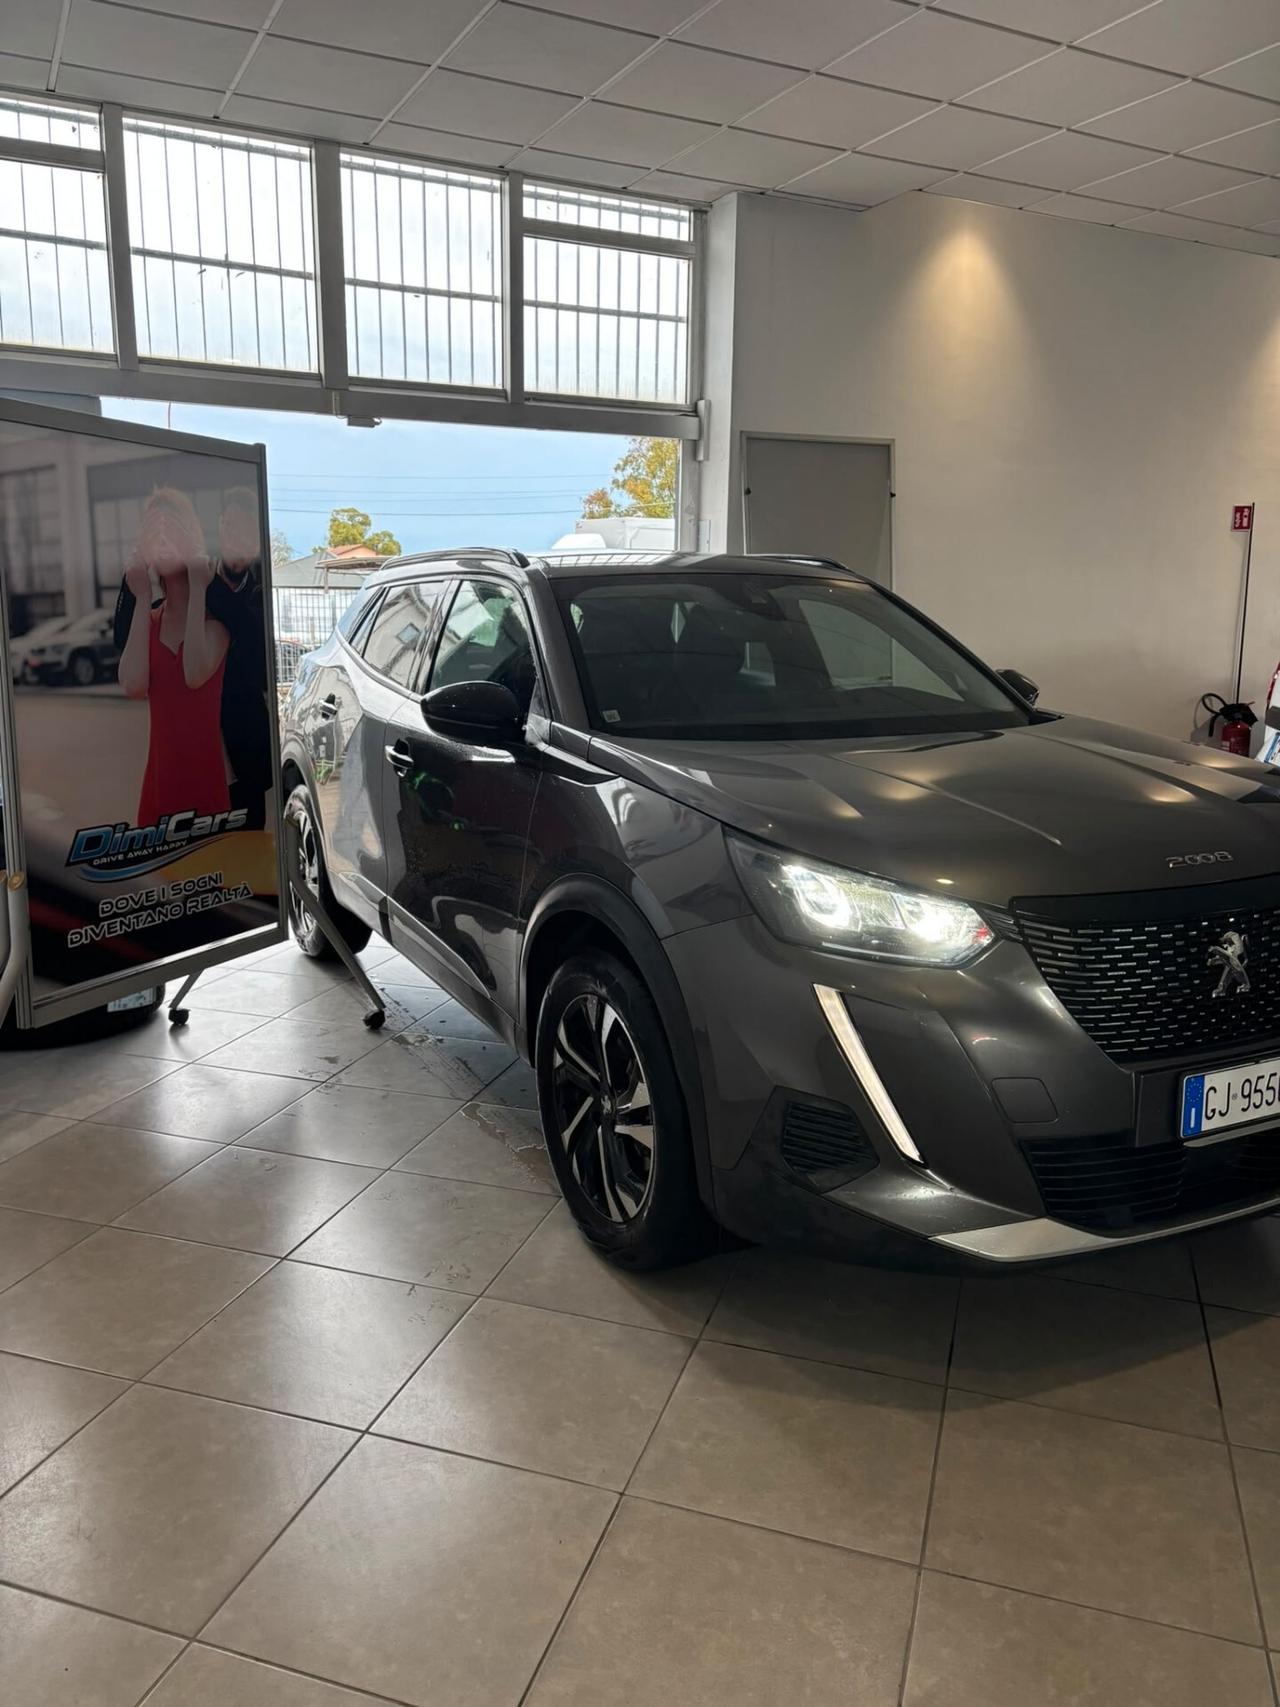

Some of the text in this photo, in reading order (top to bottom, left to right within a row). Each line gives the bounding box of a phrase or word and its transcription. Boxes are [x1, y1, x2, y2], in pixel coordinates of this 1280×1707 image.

[70, 808, 248, 862] DimiCars
[93, 839, 188, 866] DRIVE AWAY HAPPY
[1166, 851, 1233, 868] 2008
[68, 881, 253, 948] DIVENTANO REALTÀ
[99, 871, 223, 918] DOVE I SOGNI
